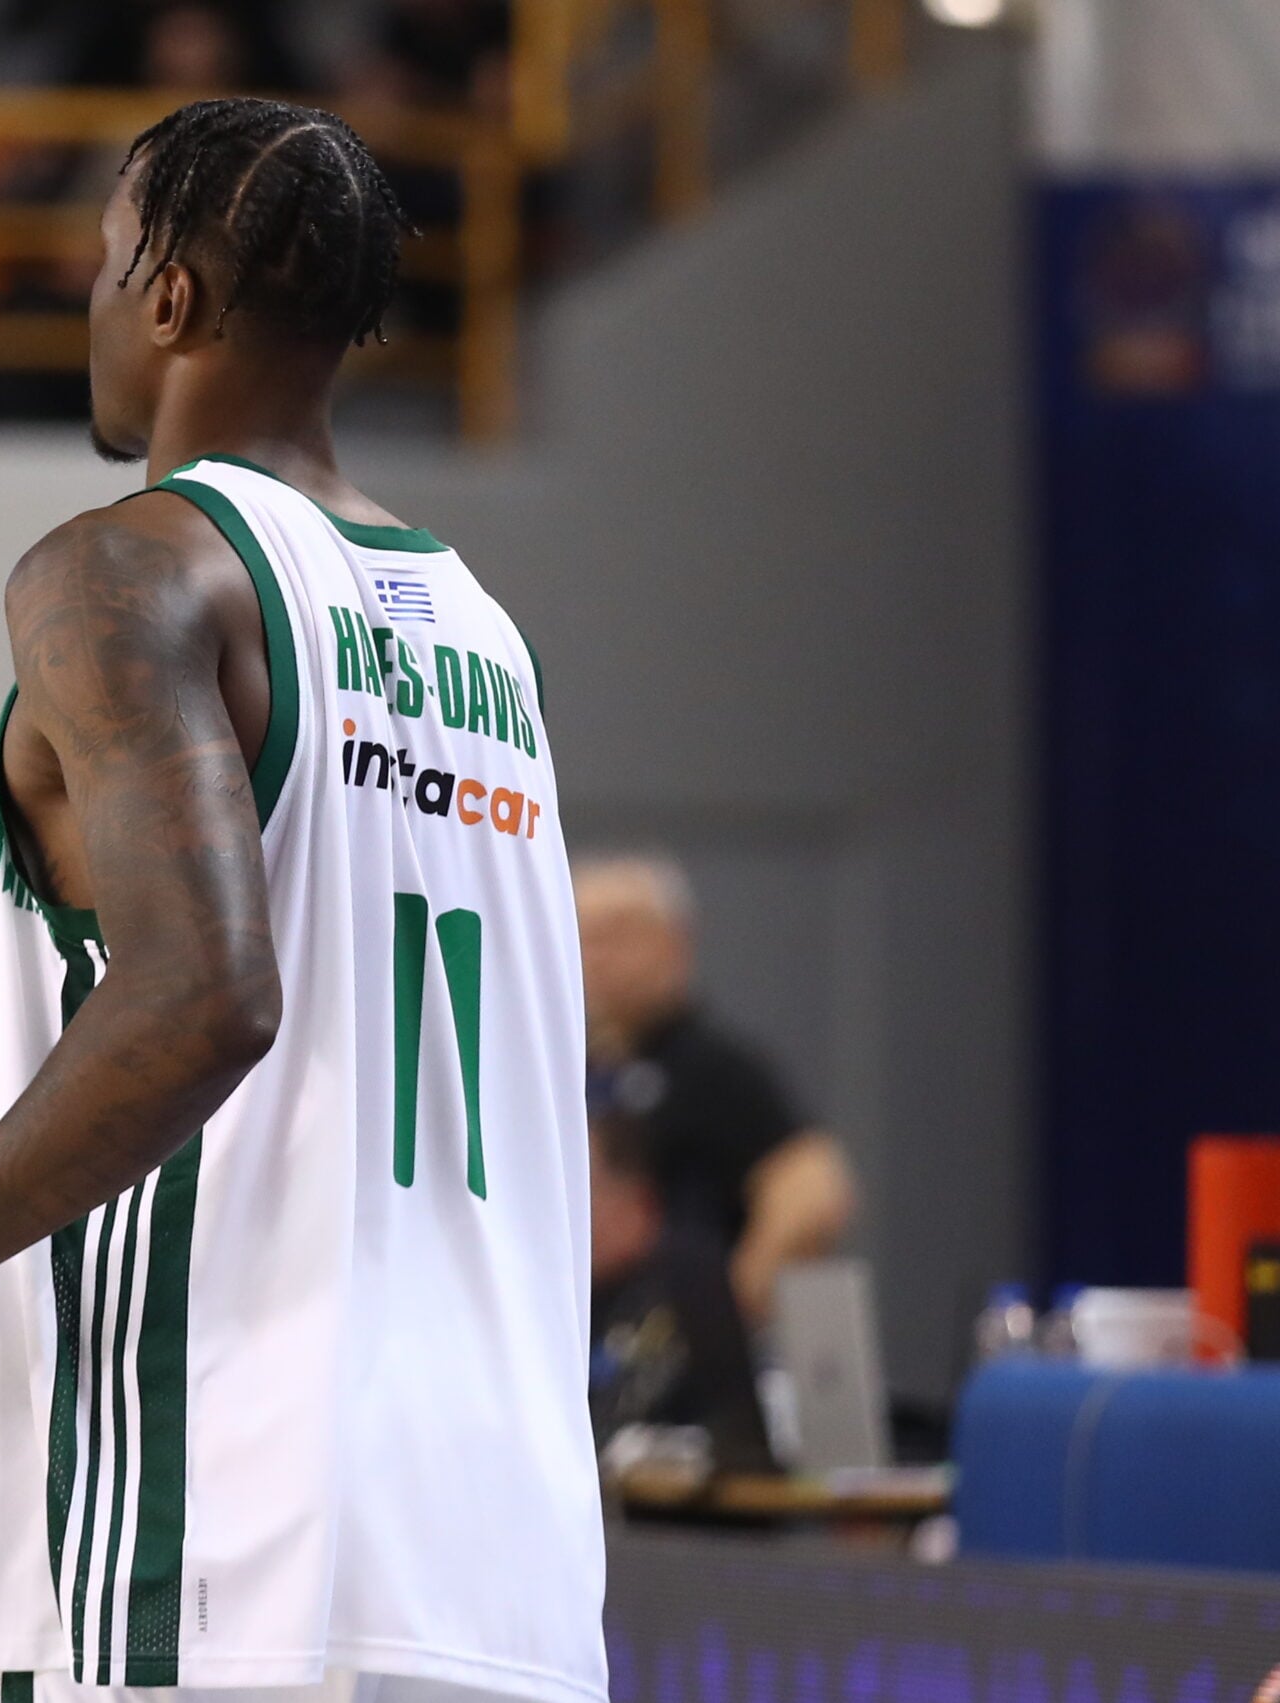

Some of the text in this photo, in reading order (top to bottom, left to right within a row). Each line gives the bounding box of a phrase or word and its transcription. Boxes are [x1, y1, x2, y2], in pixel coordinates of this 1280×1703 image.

[327, 604, 537, 760] HAES-DAVIS
[341, 717, 541, 840] intacar
[392, 891, 487, 1202] 11
